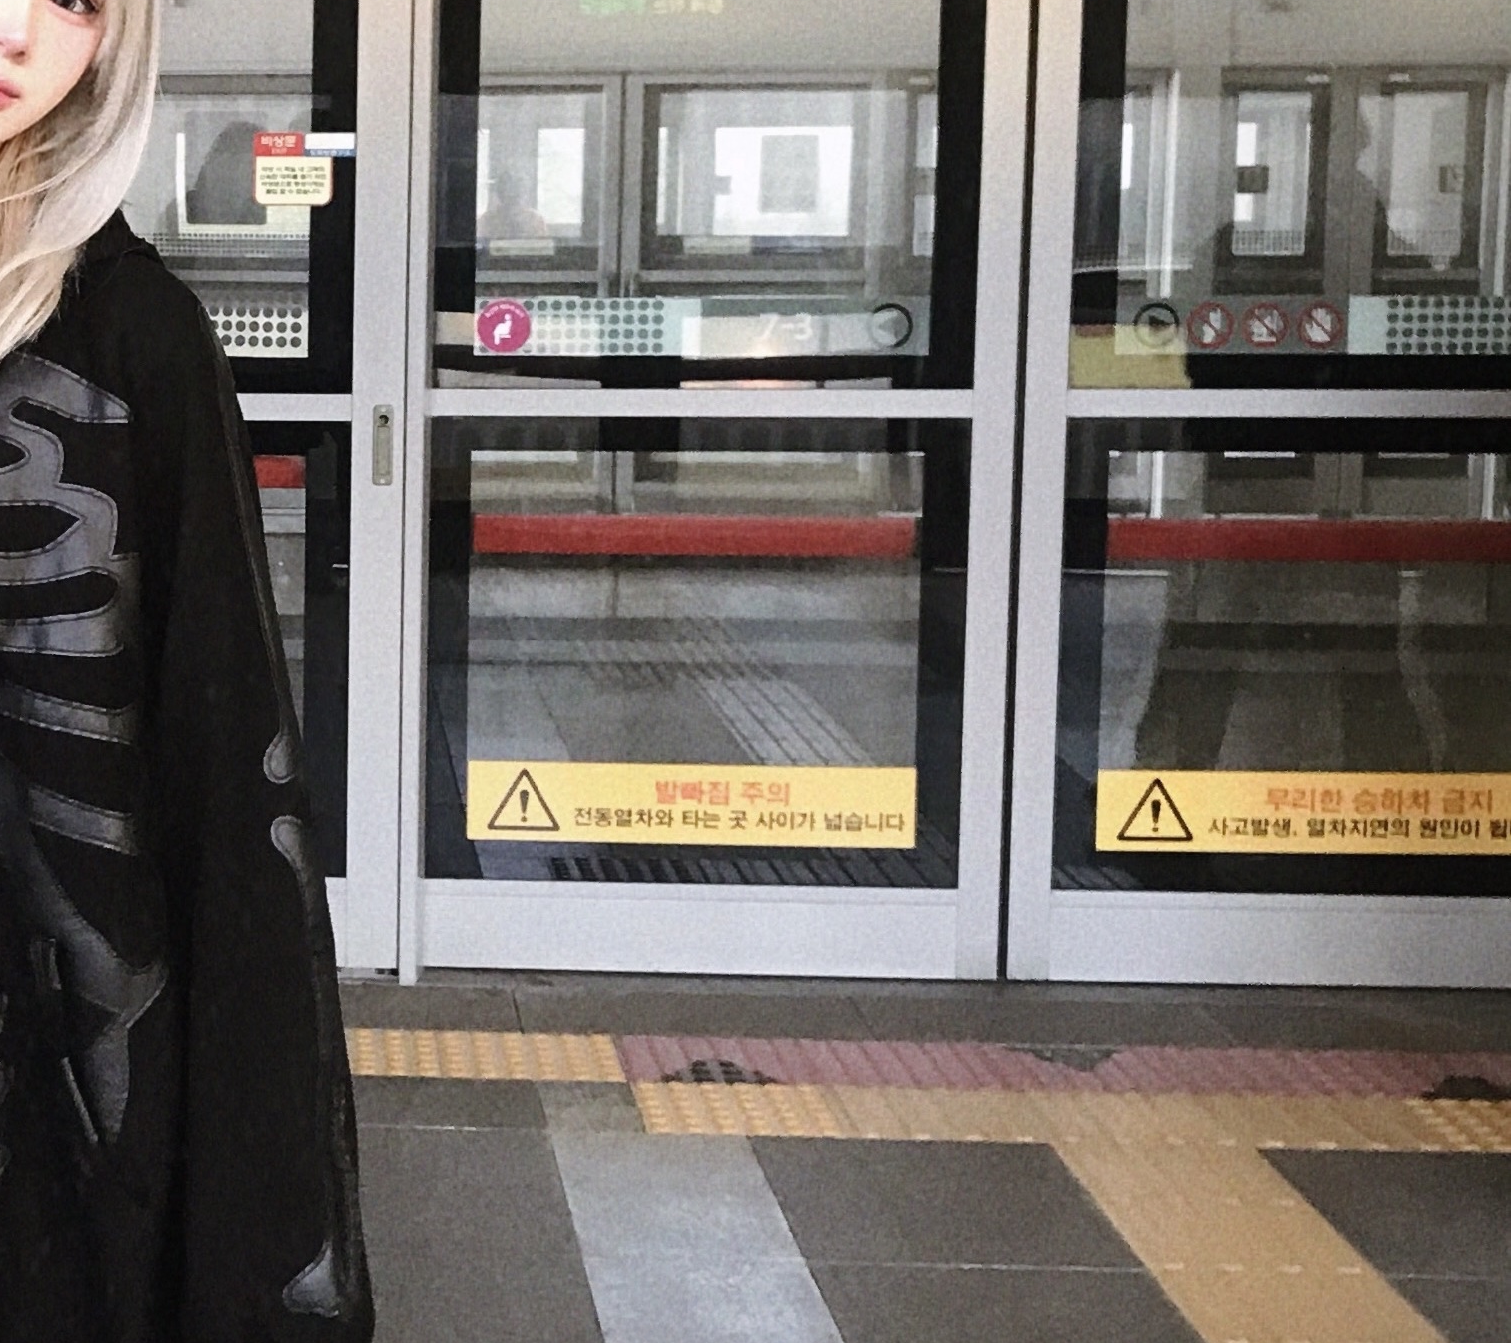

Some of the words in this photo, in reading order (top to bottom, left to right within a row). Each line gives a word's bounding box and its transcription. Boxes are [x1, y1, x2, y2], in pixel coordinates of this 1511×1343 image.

[655, 780, 730, 806] 발빠짐
[741, 780, 790, 806] 주의
[1266, 788, 1342, 813] 무리한
[1352, 787, 1430, 815] 승하차
[1443, 788, 1493, 815] 금지
[574, 807, 674, 828] 전동열차와
[681, 809, 722, 830] 타는
[728, 810, 748, 830] 곳
[755, 811, 817, 831] 사이가
[823, 812, 906, 833] 넓습니다
[1420, 818, 1481, 839] 원인이
